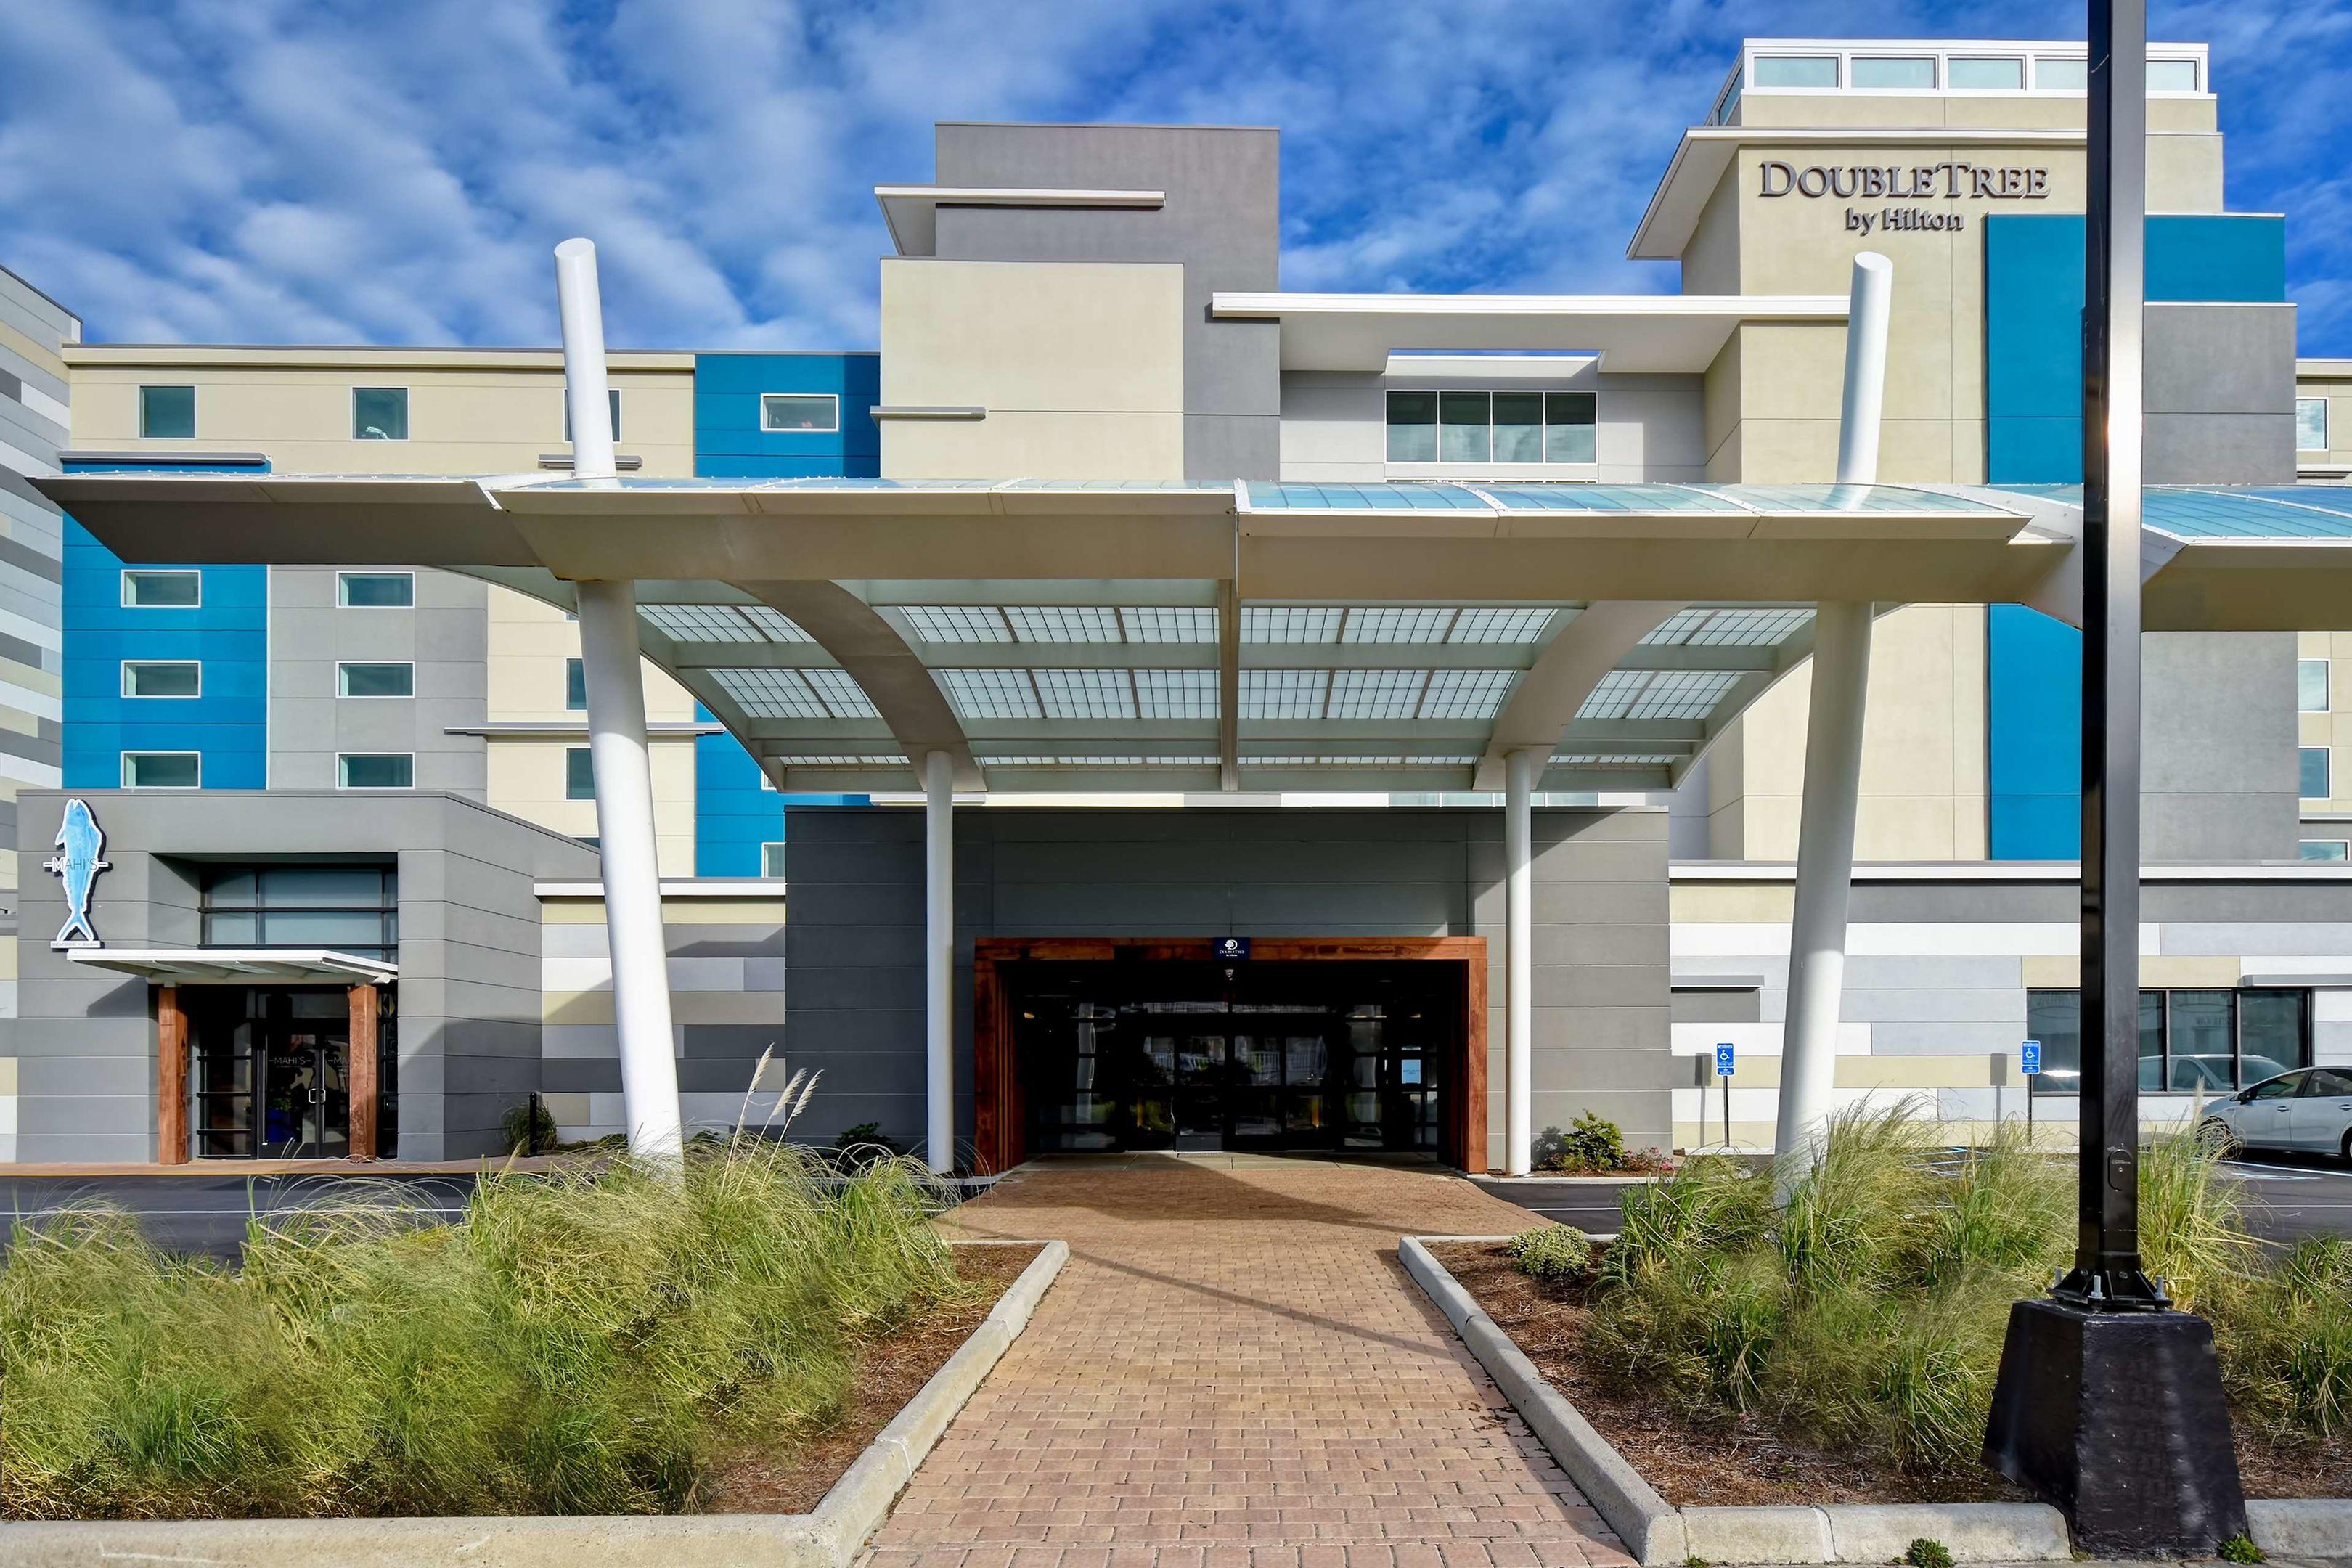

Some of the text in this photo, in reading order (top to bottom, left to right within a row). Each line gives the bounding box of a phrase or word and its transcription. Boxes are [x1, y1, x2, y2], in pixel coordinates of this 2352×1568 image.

[1845, 207, 1964, 236] by Hilton
[52, 857, 99, 872] MAHI'S
